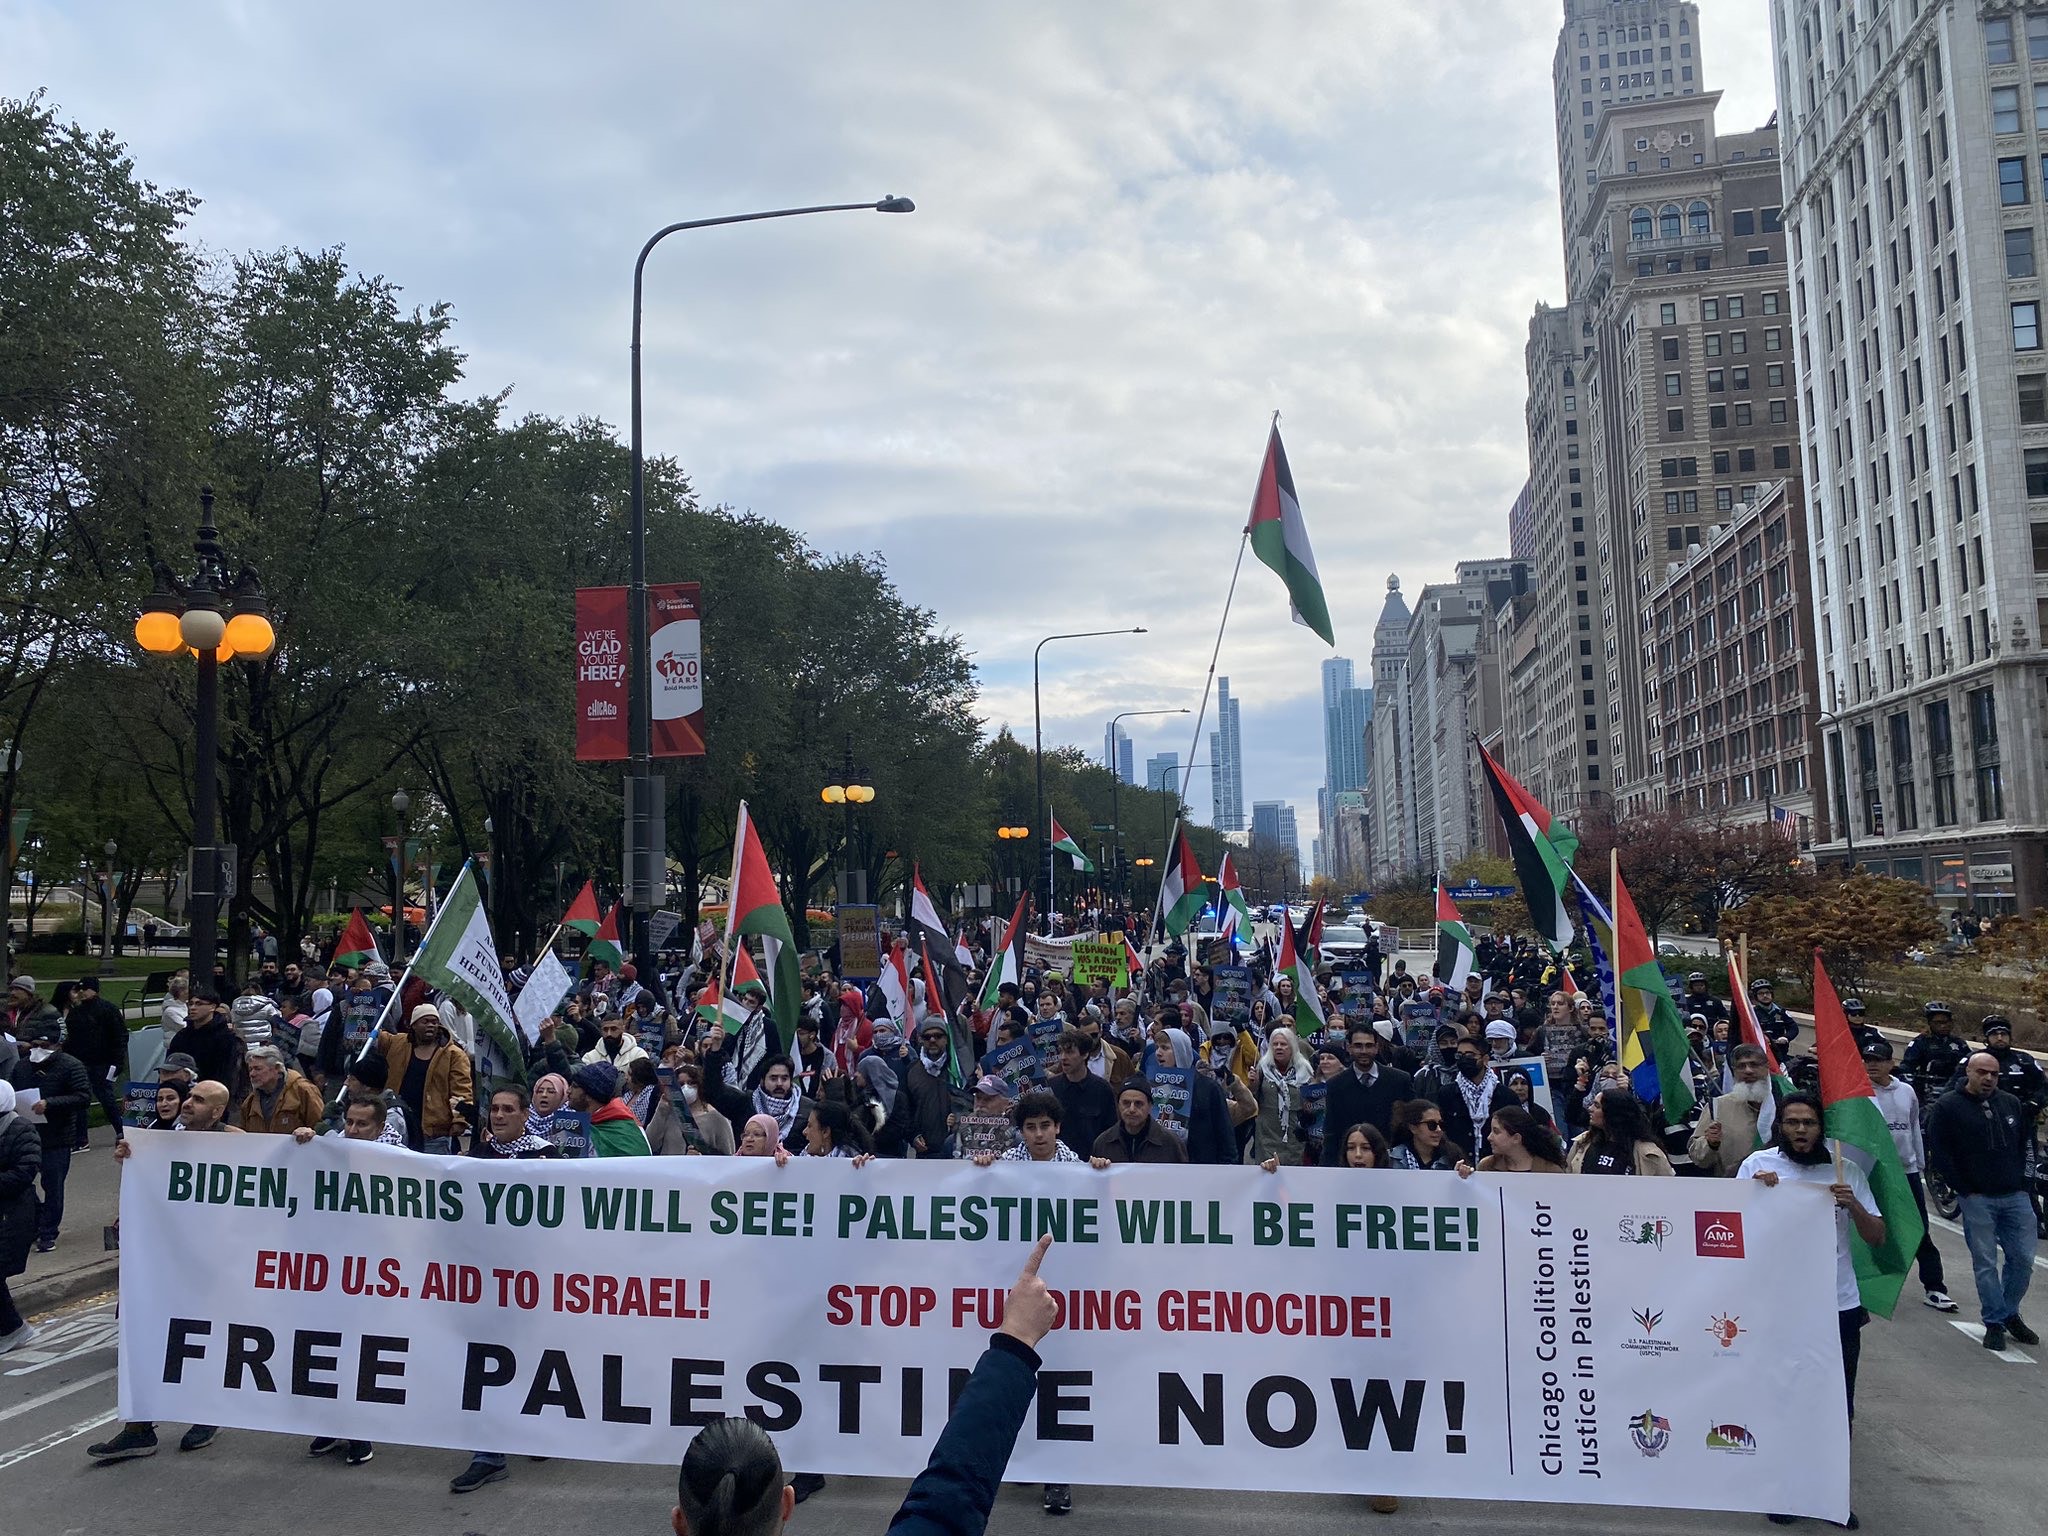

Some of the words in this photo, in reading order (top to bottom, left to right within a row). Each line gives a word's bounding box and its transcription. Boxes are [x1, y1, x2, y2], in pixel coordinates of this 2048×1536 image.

[583, 629, 616, 640] WE'RE
[578, 640, 622, 656] GLAD
[581, 653, 619, 666] YOU'RE
[580, 664, 626, 688] HERE!
[664, 661, 698, 677] 100
[665, 677, 698, 685] YEARS
[587, 699, 617, 717] CHICAGO
[1074, 943, 1117, 955] LEBANON
[475, 950, 499, 980] FUND
[1094, 955, 1100, 965] A
[1101, 956, 1122, 966] RIGHT
[459, 956, 488, 984] HELP
[1079, 964, 1088, 973] 2
[996, 1044, 1024, 1065] STOP
[1018, 1055, 1037, 1071] AID
[1012, 1074, 1030, 1088] TO
[1154, 1072, 1185, 1085] STOP
[1169, 1089, 1190, 1101] AID
[1157, 1103, 1174, 1115] TO
[135, 1115, 151, 1126] TO
[554, 1117, 581, 1130] STOP
[960, 1115, 1011, 1126] DEMOCRATS
[566, 1135, 587, 1148] AID
[973, 1132, 996, 1141] FUND
[167, 1160, 298, 1219] BIDEN,
[313, 1169, 464, 1223] HARRIS
[478, 1182, 565, 1229] YOU
[580, 1187, 692, 1233] WILL
[709, 1190, 815, 1238] SEE!
[837, 1194, 1099, 1244] PALESTINE
[1116, 1199, 1234, 1245] WILL
[1252, 1201, 1316, 1248] BE
[1335, 1203, 1480, 1252] FREE!
[1530, 1201, 1553, 1238] for
[1706, 1230, 1735, 1241] AMP
[254, 1250, 329, 1292] END
[341, 1255, 410, 1299] U.S.
[420, 1261, 482, 1305] AID
[492, 1268, 540, 1311] TO
[553, 1273, 711, 1320] ISRAEL!
[1568, 1227, 1593, 1345] Palestine
[826, 1284, 937, 1328] STOP
[952, 1287, 1142, 1331] FUDING
[1157, 1289, 1392, 1339] GENOCIDE!
[1533, 1247, 1557, 1362] Coalition
[1620, 1343, 1654, 1351] COMMUNITY
[1638, 1338, 1672, 1347] PALESTINIAN
[1639, 1350, 1662, 1358] (USPCN)
[1571, 1355, 1595, 1379] in
[162, 1317, 410, 1406] FREE
[1158, 1371, 1467, 1455] NOW!
[1539, 1371, 1565, 1477] Chicago
[1574, 1388, 1602, 1480] Justice
